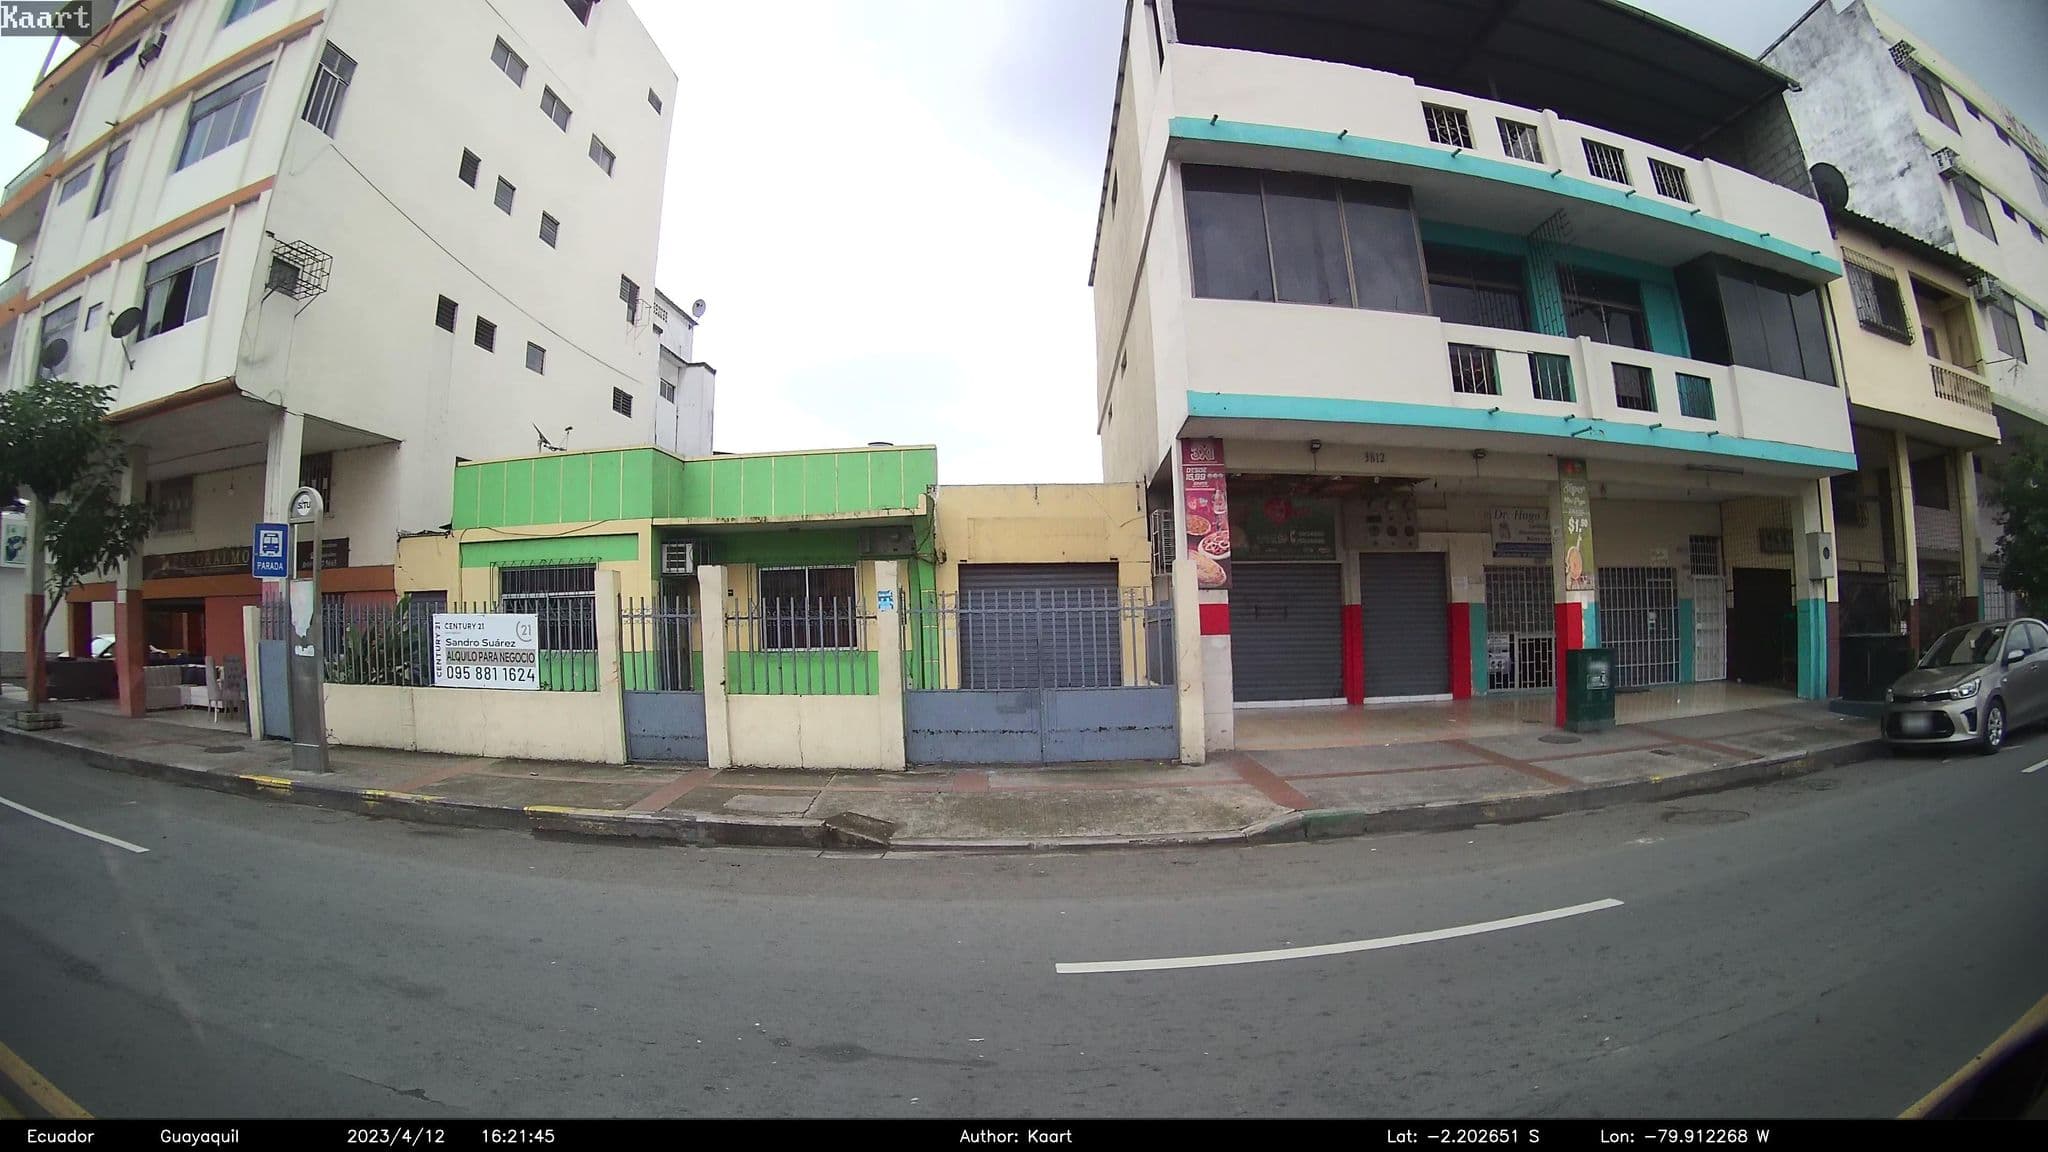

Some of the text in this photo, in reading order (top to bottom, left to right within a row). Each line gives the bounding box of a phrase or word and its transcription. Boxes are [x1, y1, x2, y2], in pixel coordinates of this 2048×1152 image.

[257, 562, 284, 570] PARADA
[444, 622, 476, 630] CENTURY
[521, 624, 532, 636] 21
[445, 638, 516, 648] Sandro Suárez
[435, 621, 443, 678] CENTURY 21
[446, 650, 536, 663] ALQUILO PARA NEGOCIO
[446, 666, 535, 682] 095 881 1624
